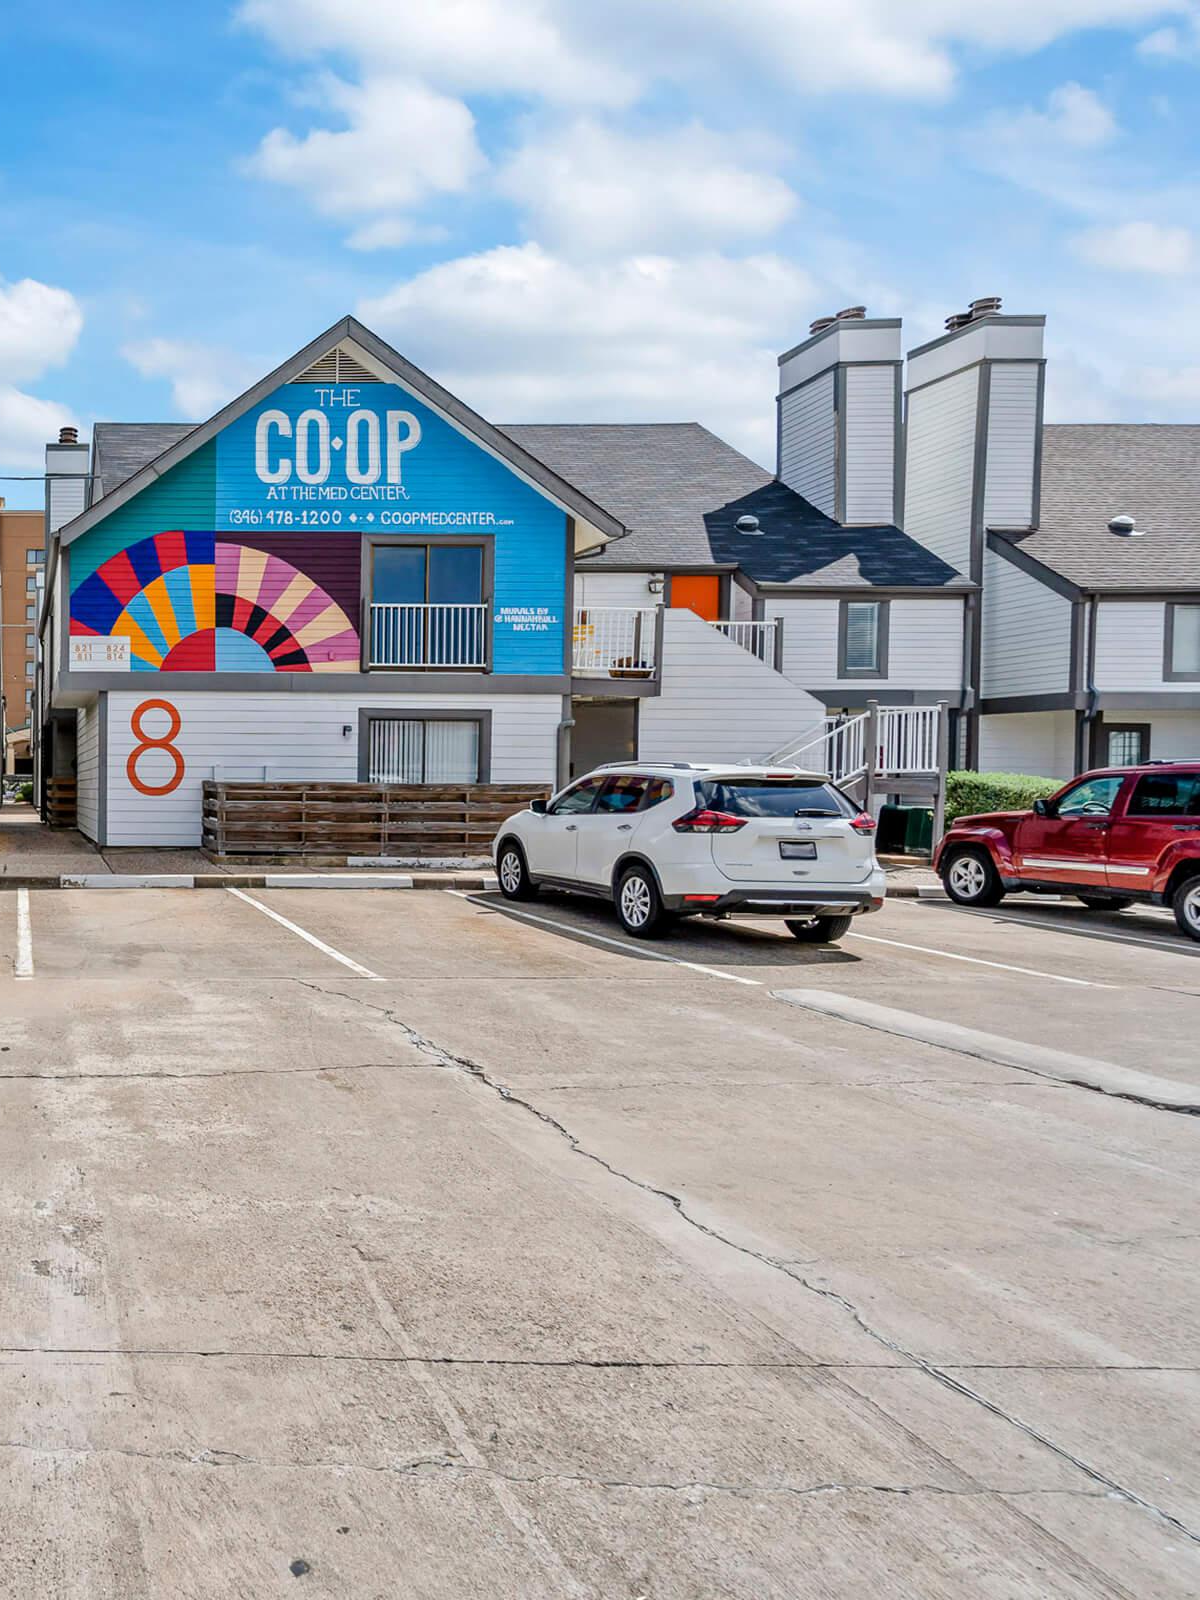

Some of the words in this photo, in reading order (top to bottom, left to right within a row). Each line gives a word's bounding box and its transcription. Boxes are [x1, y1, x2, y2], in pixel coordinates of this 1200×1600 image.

[314, 389, 361, 407] THE
[266, 486, 289, 501] AT
[290, 486, 317, 501] THE
[318, 486, 348, 501] MED
[349, 486, 411, 501] CENTER
[265, 510, 342, 525] 478-1200
[126, 698, 186, 797] 8
